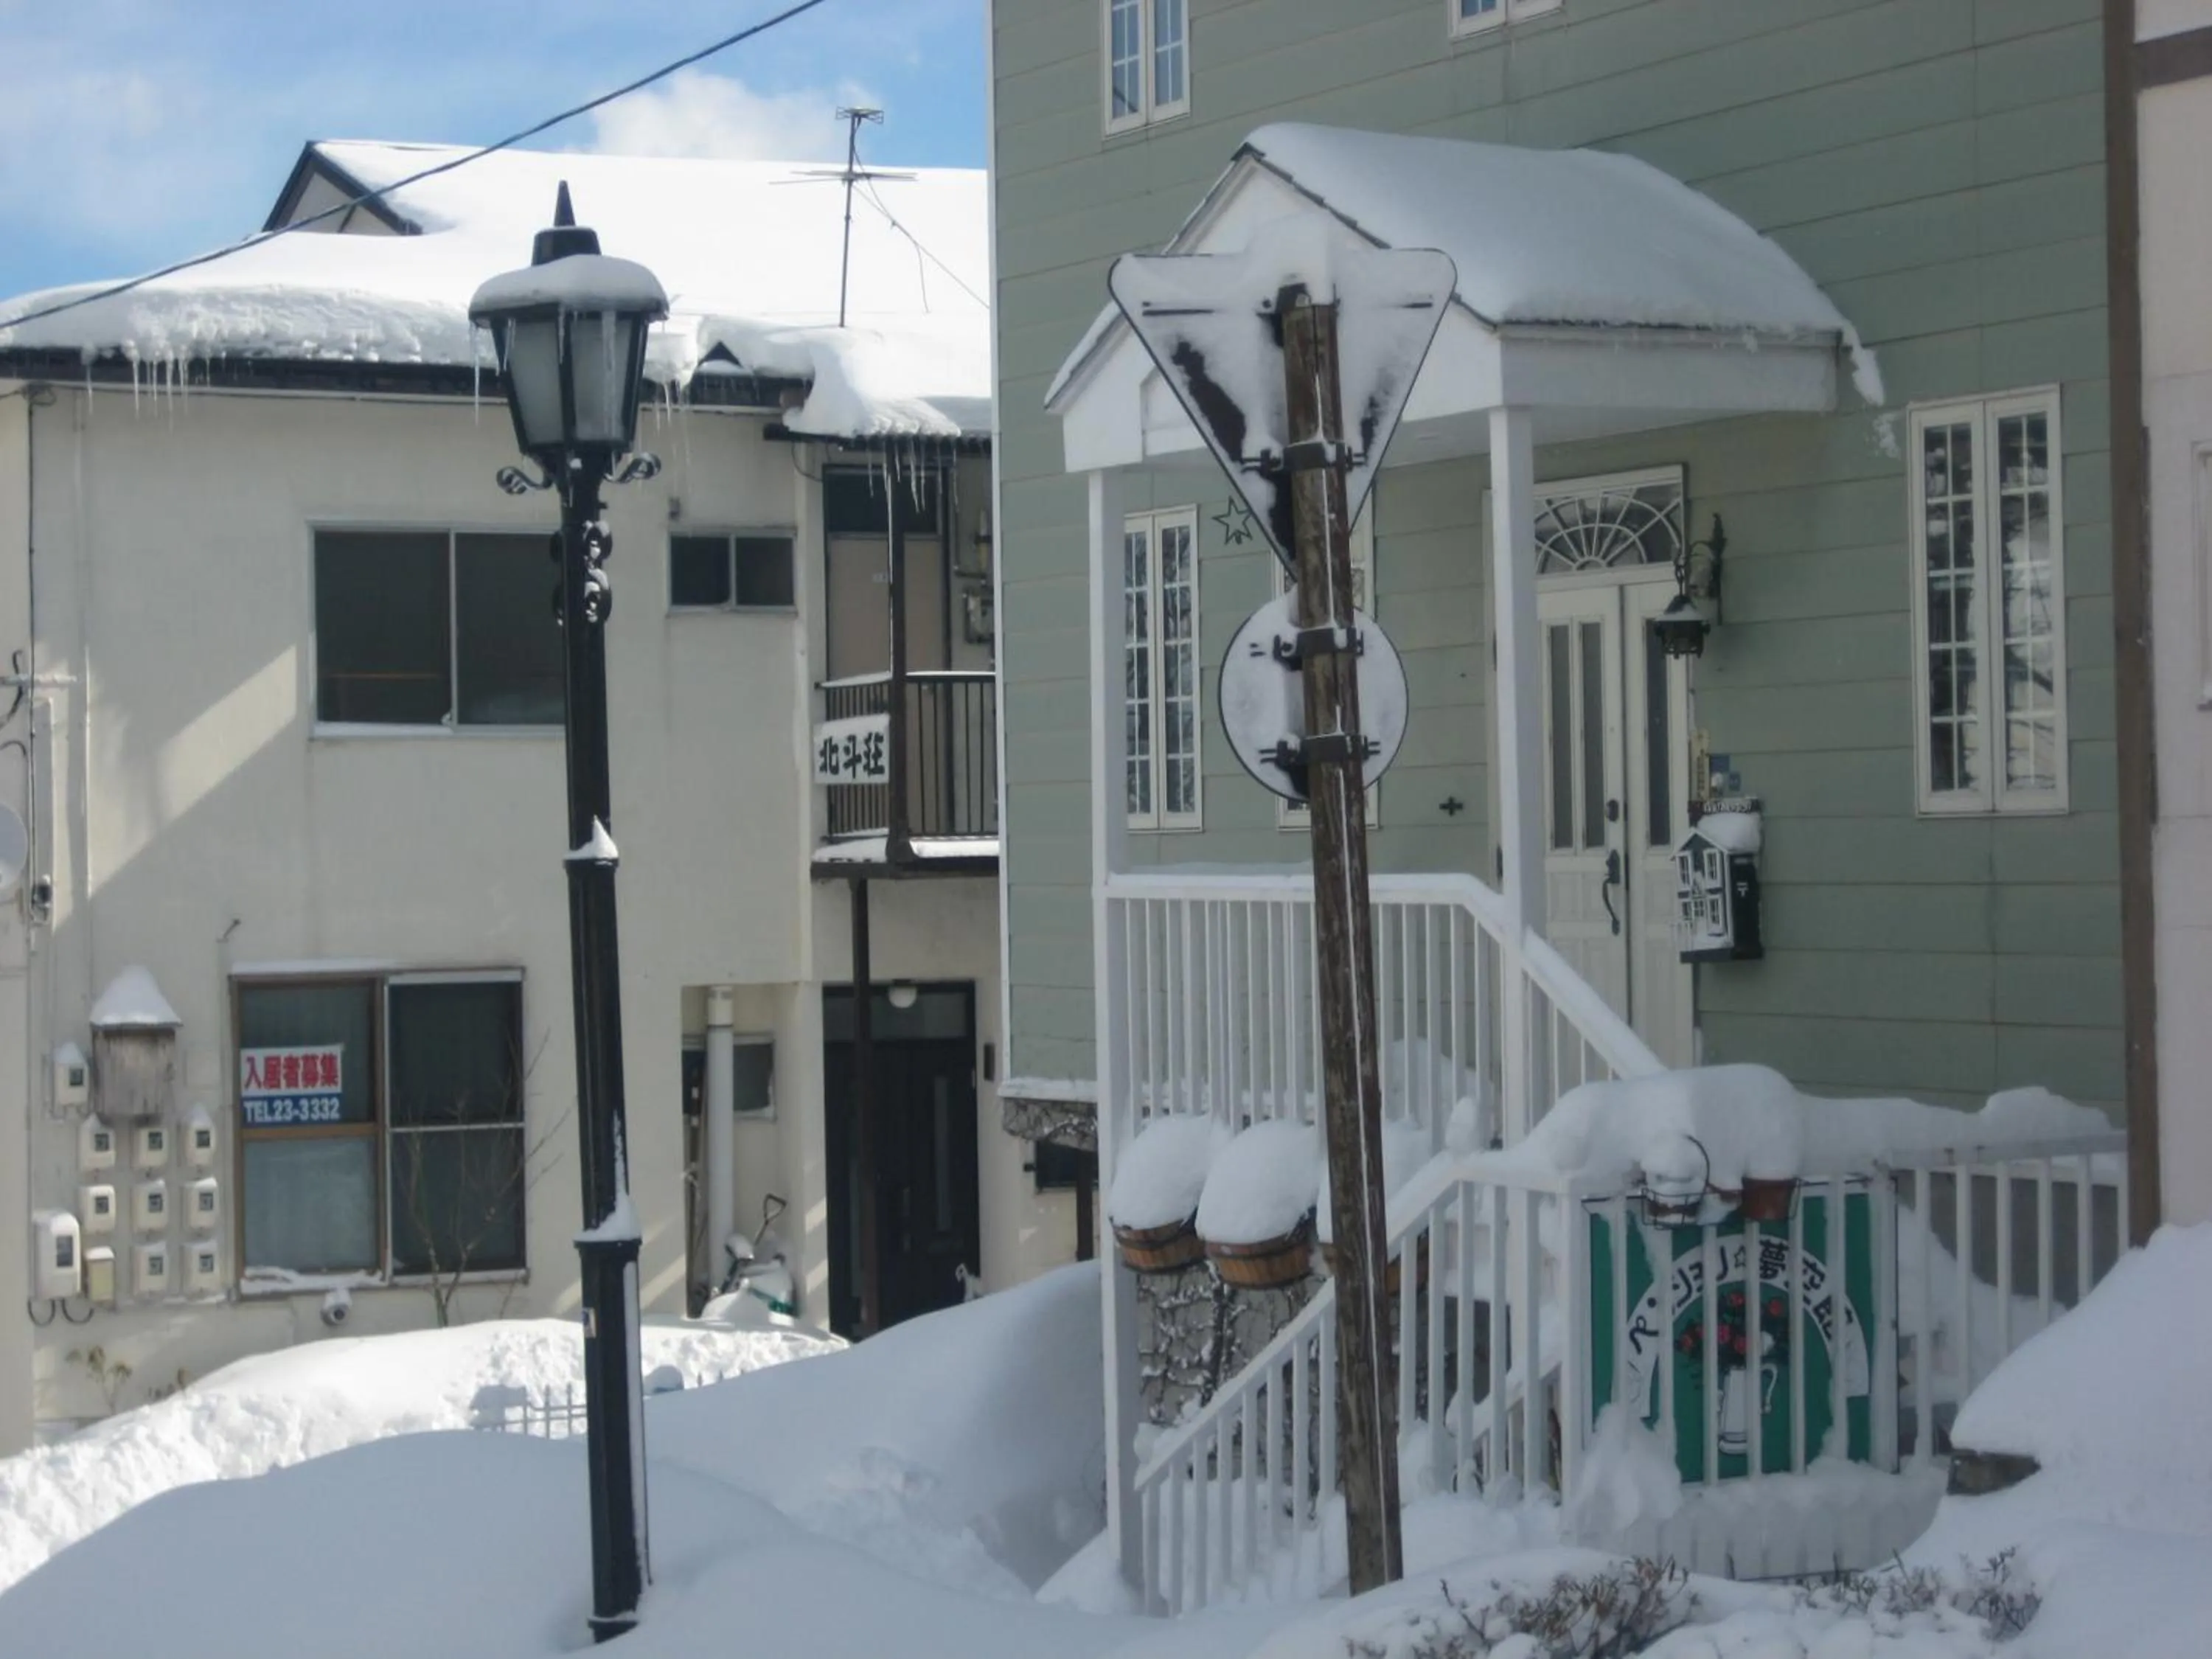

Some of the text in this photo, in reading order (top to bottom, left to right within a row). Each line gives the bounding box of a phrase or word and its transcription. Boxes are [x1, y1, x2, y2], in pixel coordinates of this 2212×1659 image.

[243, 1053, 339, 1090] 入居者募集
